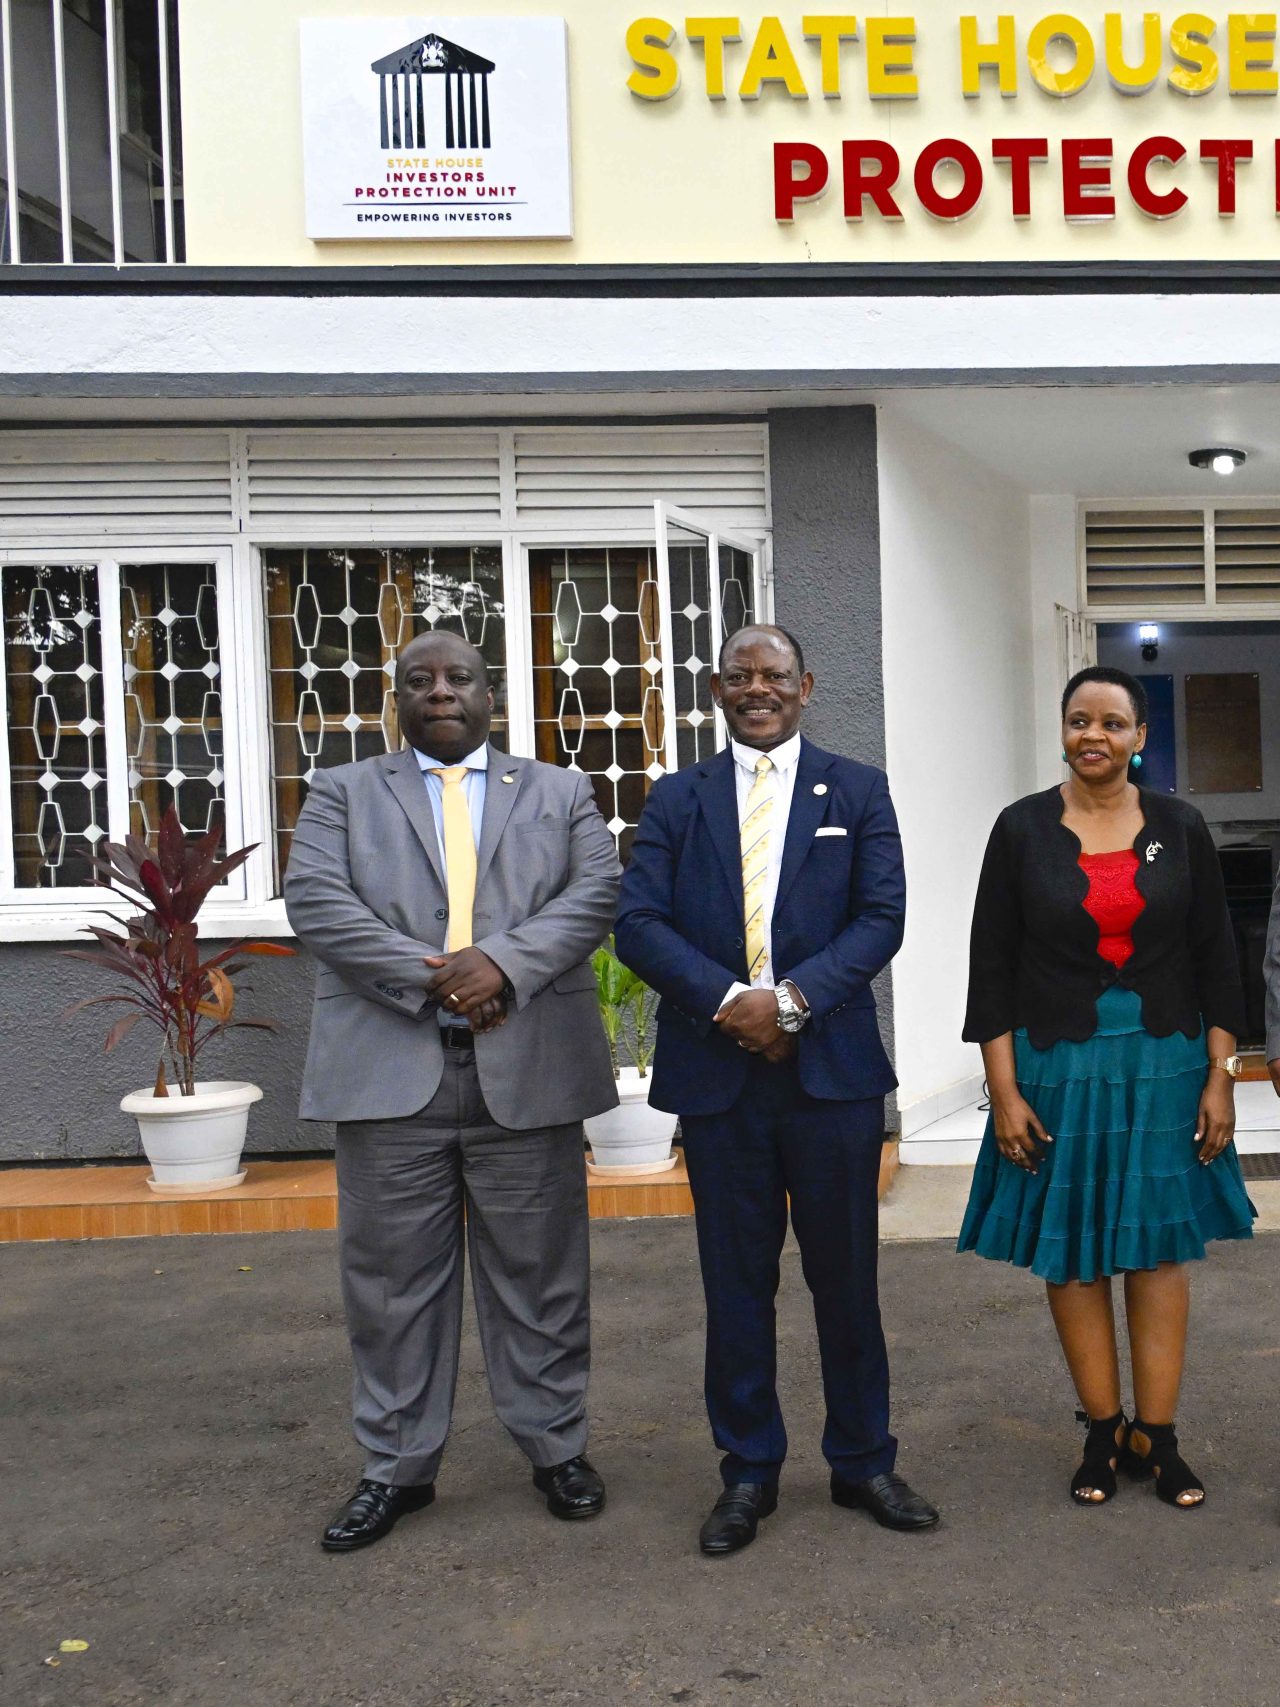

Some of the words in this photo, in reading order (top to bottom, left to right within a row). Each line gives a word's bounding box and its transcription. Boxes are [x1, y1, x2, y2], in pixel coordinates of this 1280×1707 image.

[626, 16, 919, 100] STATE
[959, 13, 1279, 98] HOUSE
[387, 158, 430, 168] STATE
[435, 158, 483, 168] HOUSE
[386, 172, 485, 182] INVESTORS
[355, 186, 467, 198] PROTECTION
[476, 186, 517, 197] UNIT
[357, 213, 440, 222] EMPOWERING
[445, 212, 512, 221] INVESTORS
